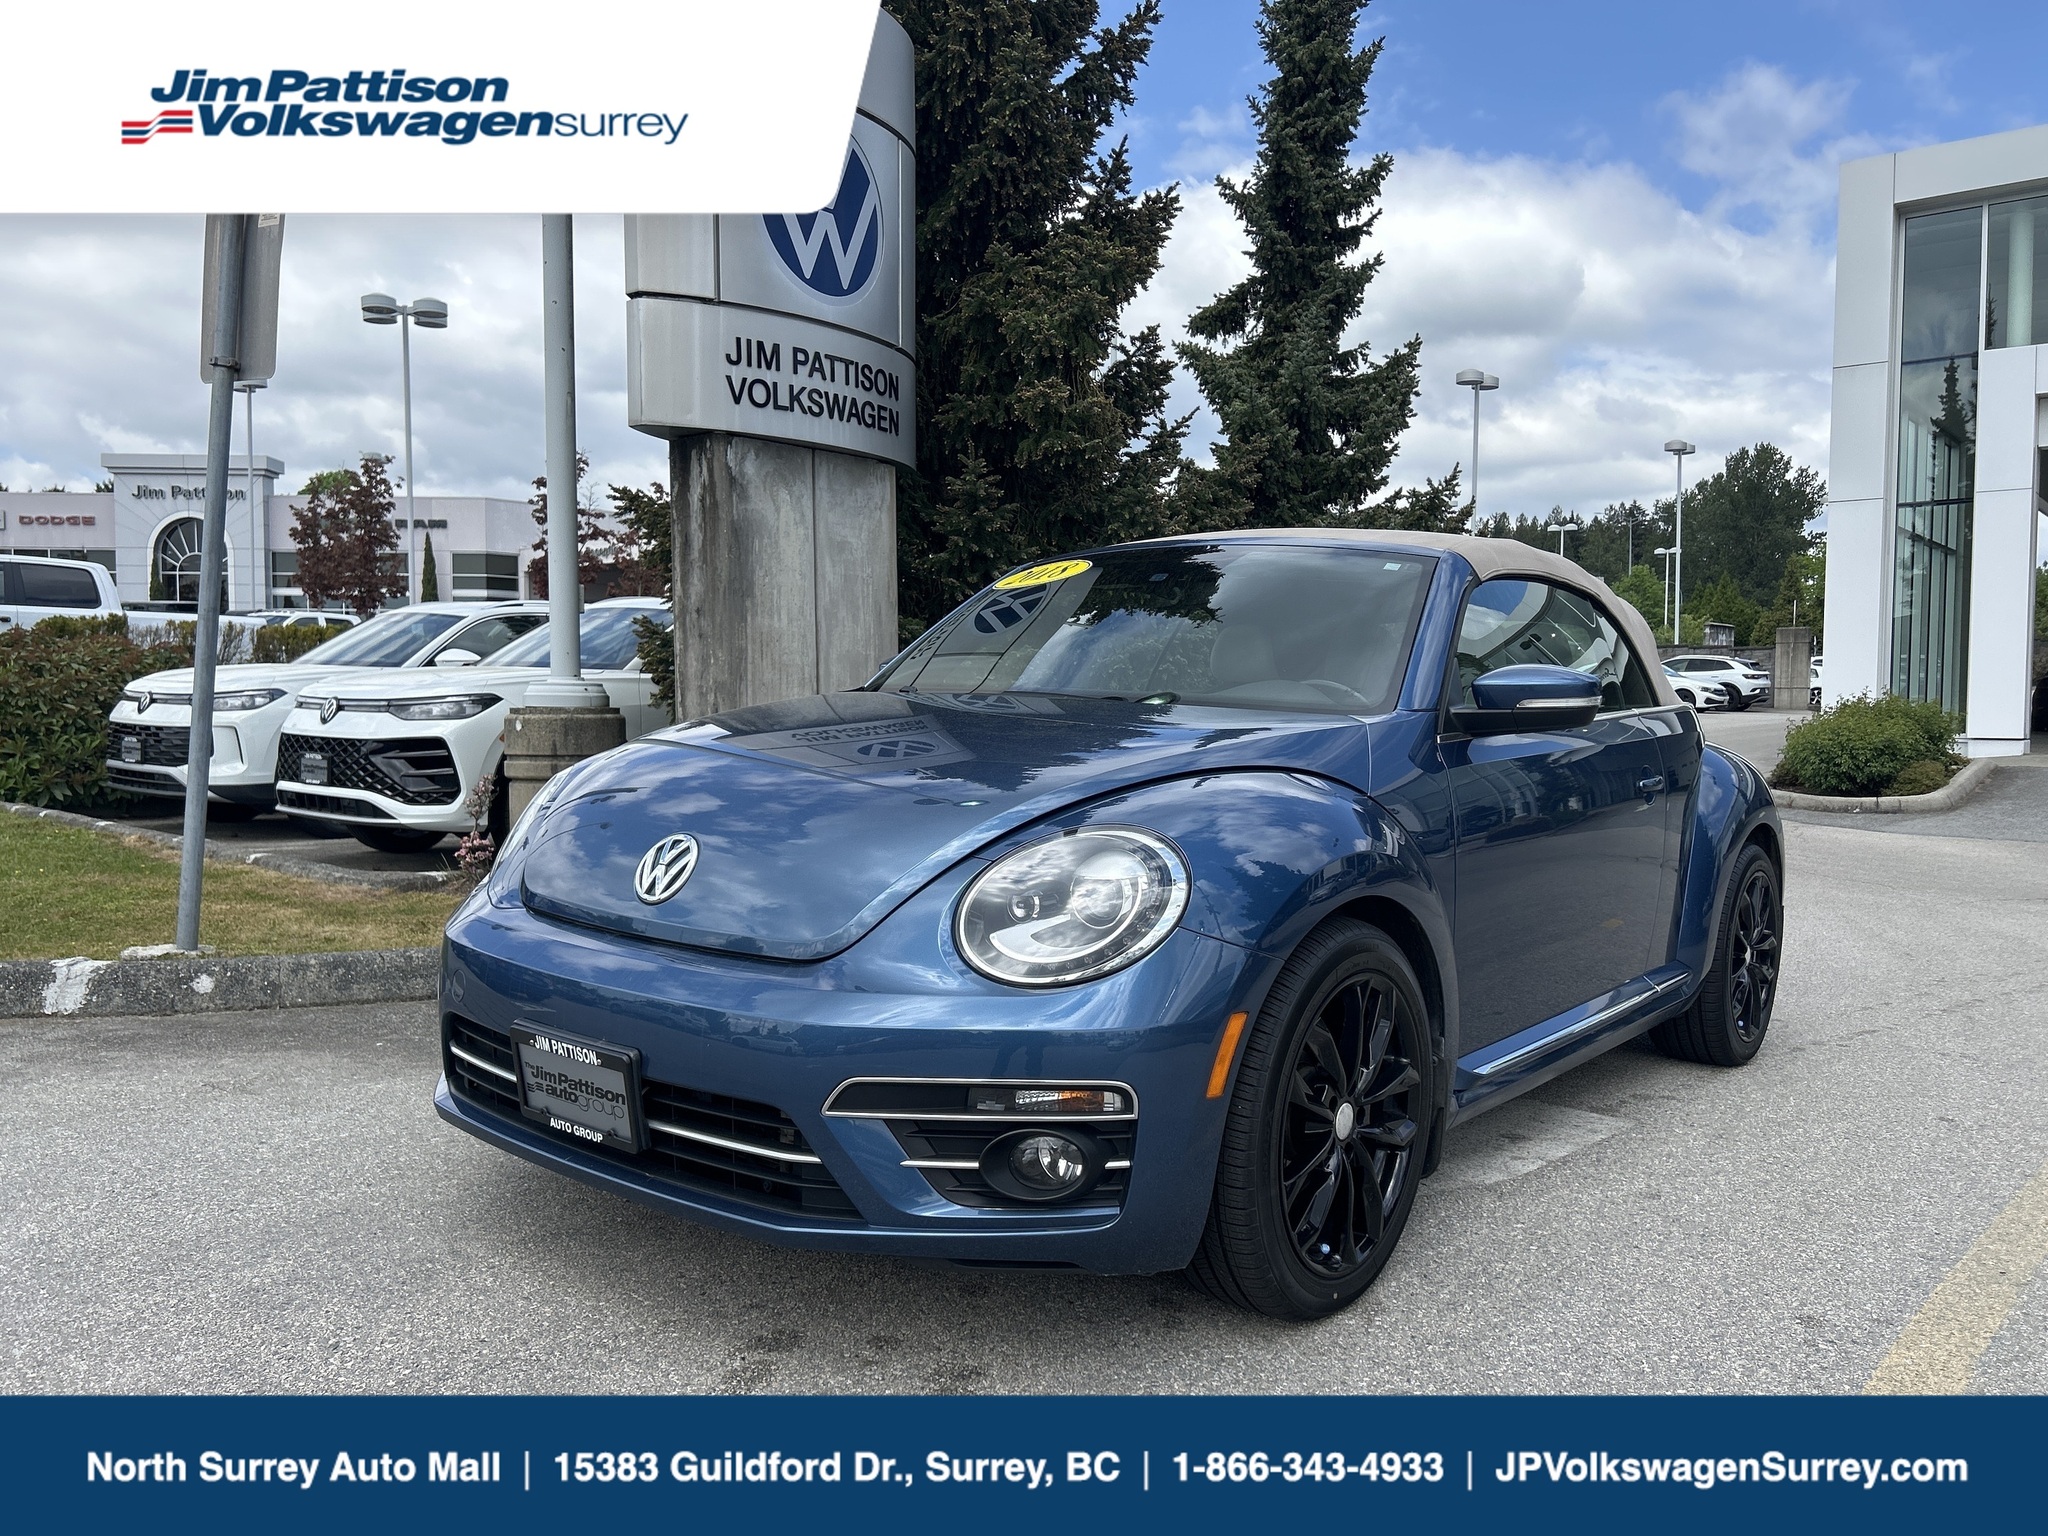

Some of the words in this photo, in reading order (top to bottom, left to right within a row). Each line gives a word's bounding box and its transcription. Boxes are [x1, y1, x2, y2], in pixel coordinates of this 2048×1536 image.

[725, 336, 780, 371] JIM
[792, 346, 899, 402] PATTISON
[725, 374, 899, 437] VOLKSWAGEN
[132, 485, 164, 499] Jim
[171, 485, 245, 500] Patton
[19, 515, 96, 526] DODGE
[1003, 562, 1080, 586] 2018
[635, 834, 698, 904] VW
[534, 1034, 551, 1053] JIM
[551, 1039, 598, 1066] PATTISON
[524, 1061, 536, 1071] The
[549, 1117, 572, 1133] AUTO
[573, 1125, 603, 1143] GROUP
